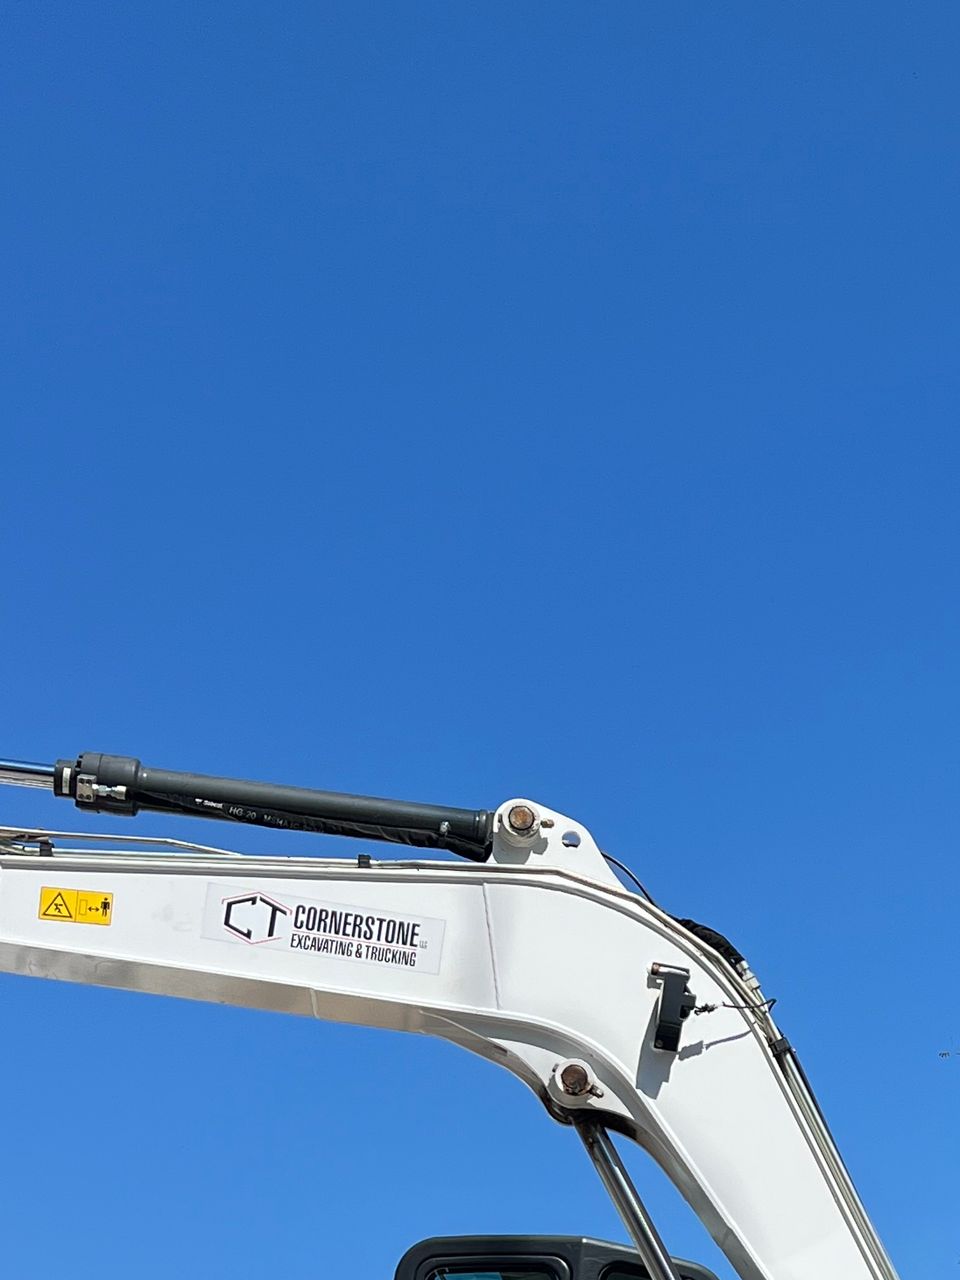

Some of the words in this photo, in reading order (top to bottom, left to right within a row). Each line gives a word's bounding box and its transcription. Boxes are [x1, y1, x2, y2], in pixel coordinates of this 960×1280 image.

[293, 904, 421, 948] CORNERSTONE
[290, 933, 354, 957] EXCAVATING
[354, 944, 363, 959] &
[364, 944, 417, 967] TRUCKING
